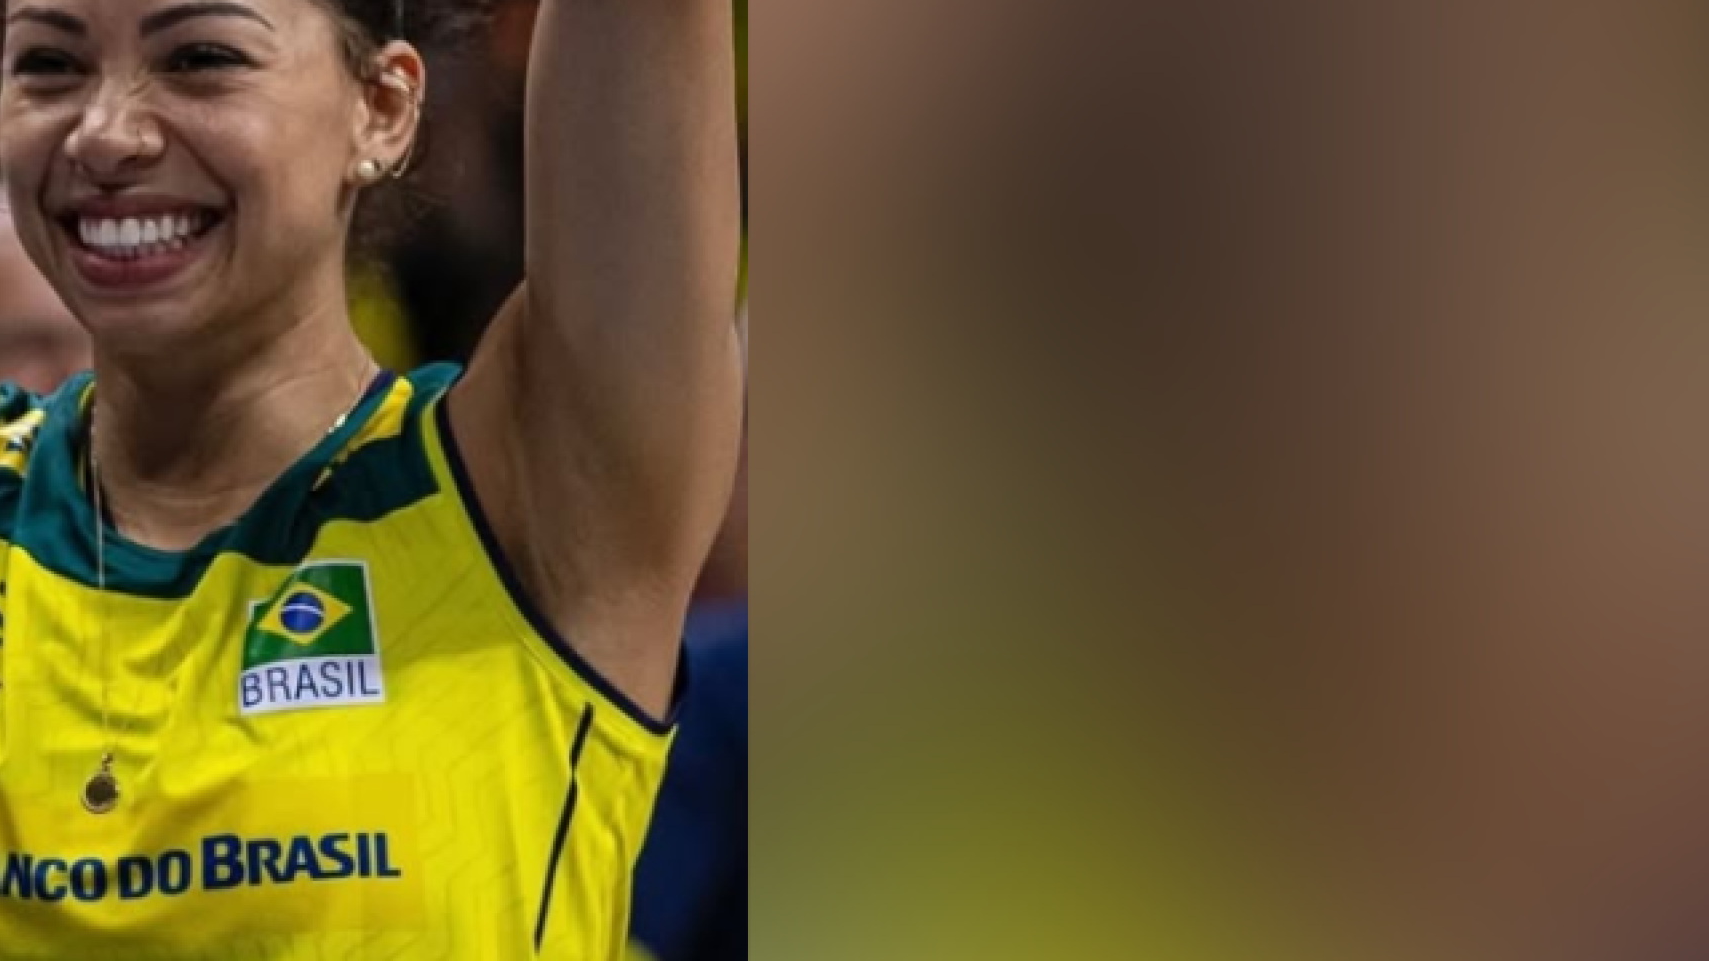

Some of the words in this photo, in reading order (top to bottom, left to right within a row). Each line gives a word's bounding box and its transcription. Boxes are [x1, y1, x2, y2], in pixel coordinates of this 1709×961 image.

[242, 660, 380, 708] BRASIL
[119, 850, 192, 898] DO
[202, 833, 401, 890] BRASIL
